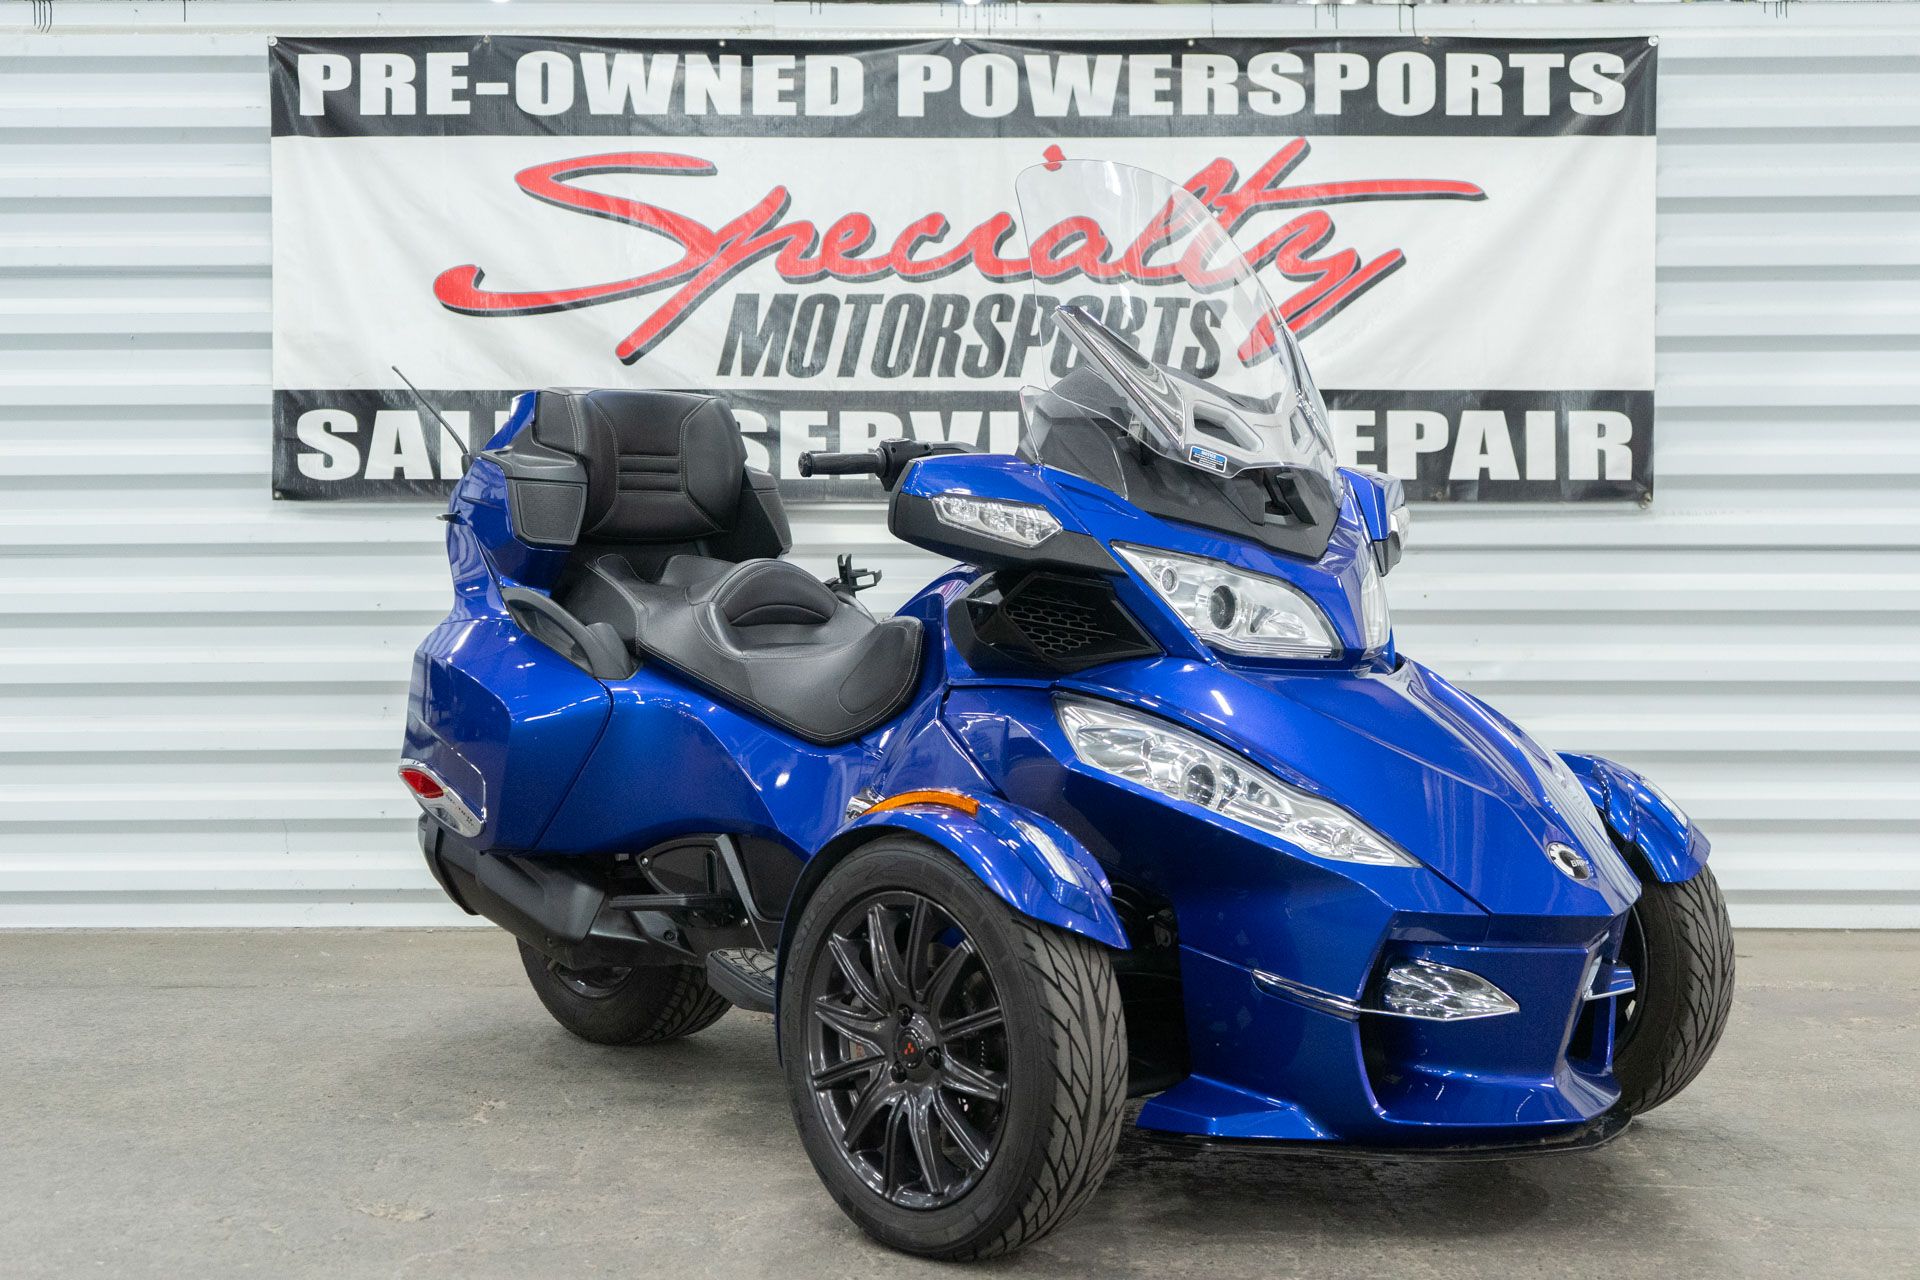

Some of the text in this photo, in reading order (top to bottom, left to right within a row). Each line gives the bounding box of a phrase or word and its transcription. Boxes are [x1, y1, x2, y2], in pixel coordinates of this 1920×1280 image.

[297, 50, 1627, 118] PRE-OWNED POWERSPORTS
[433, 136, 1489, 366] Specialty
[716, 292, 1229, 380] MOTORSPORTS
[296, 408, 509, 481] SAL
[1328, 409, 1634, 481] EPAIR
